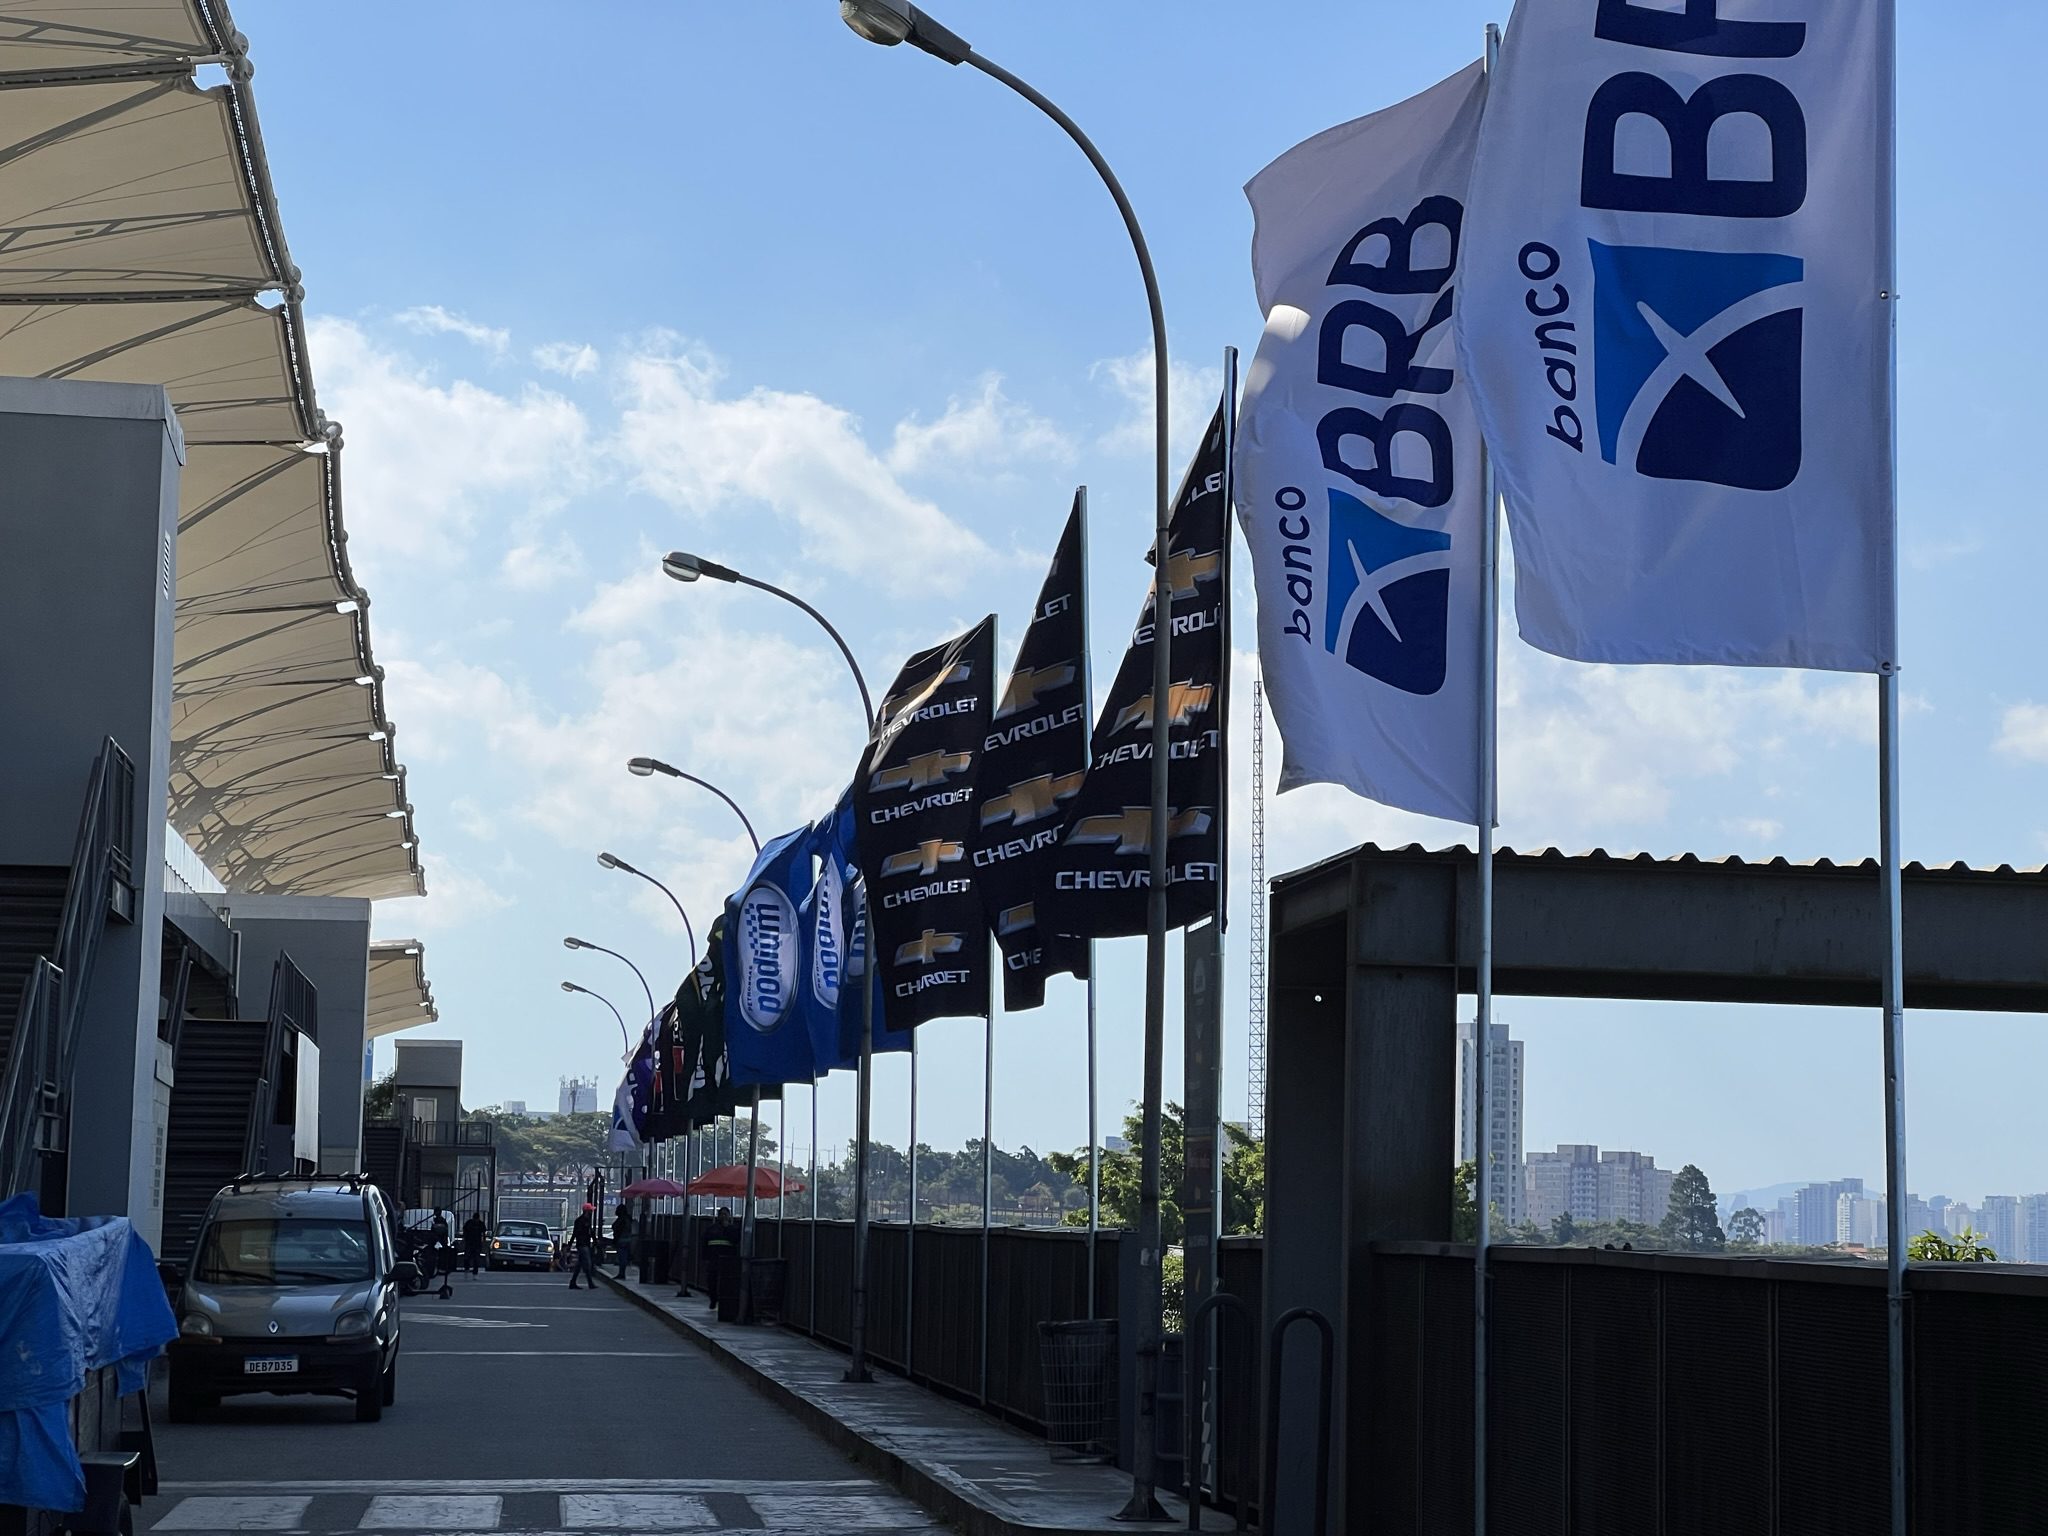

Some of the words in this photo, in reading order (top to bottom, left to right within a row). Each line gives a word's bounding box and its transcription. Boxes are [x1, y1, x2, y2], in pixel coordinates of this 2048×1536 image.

[1317, 195, 1464, 508] BRB
[1518, 241, 1583, 453] banco
[1275, 486, 1312, 645] banco
[1056, 862, 1218, 891] CHEVRLET
[753, 903, 785, 1014] podium
